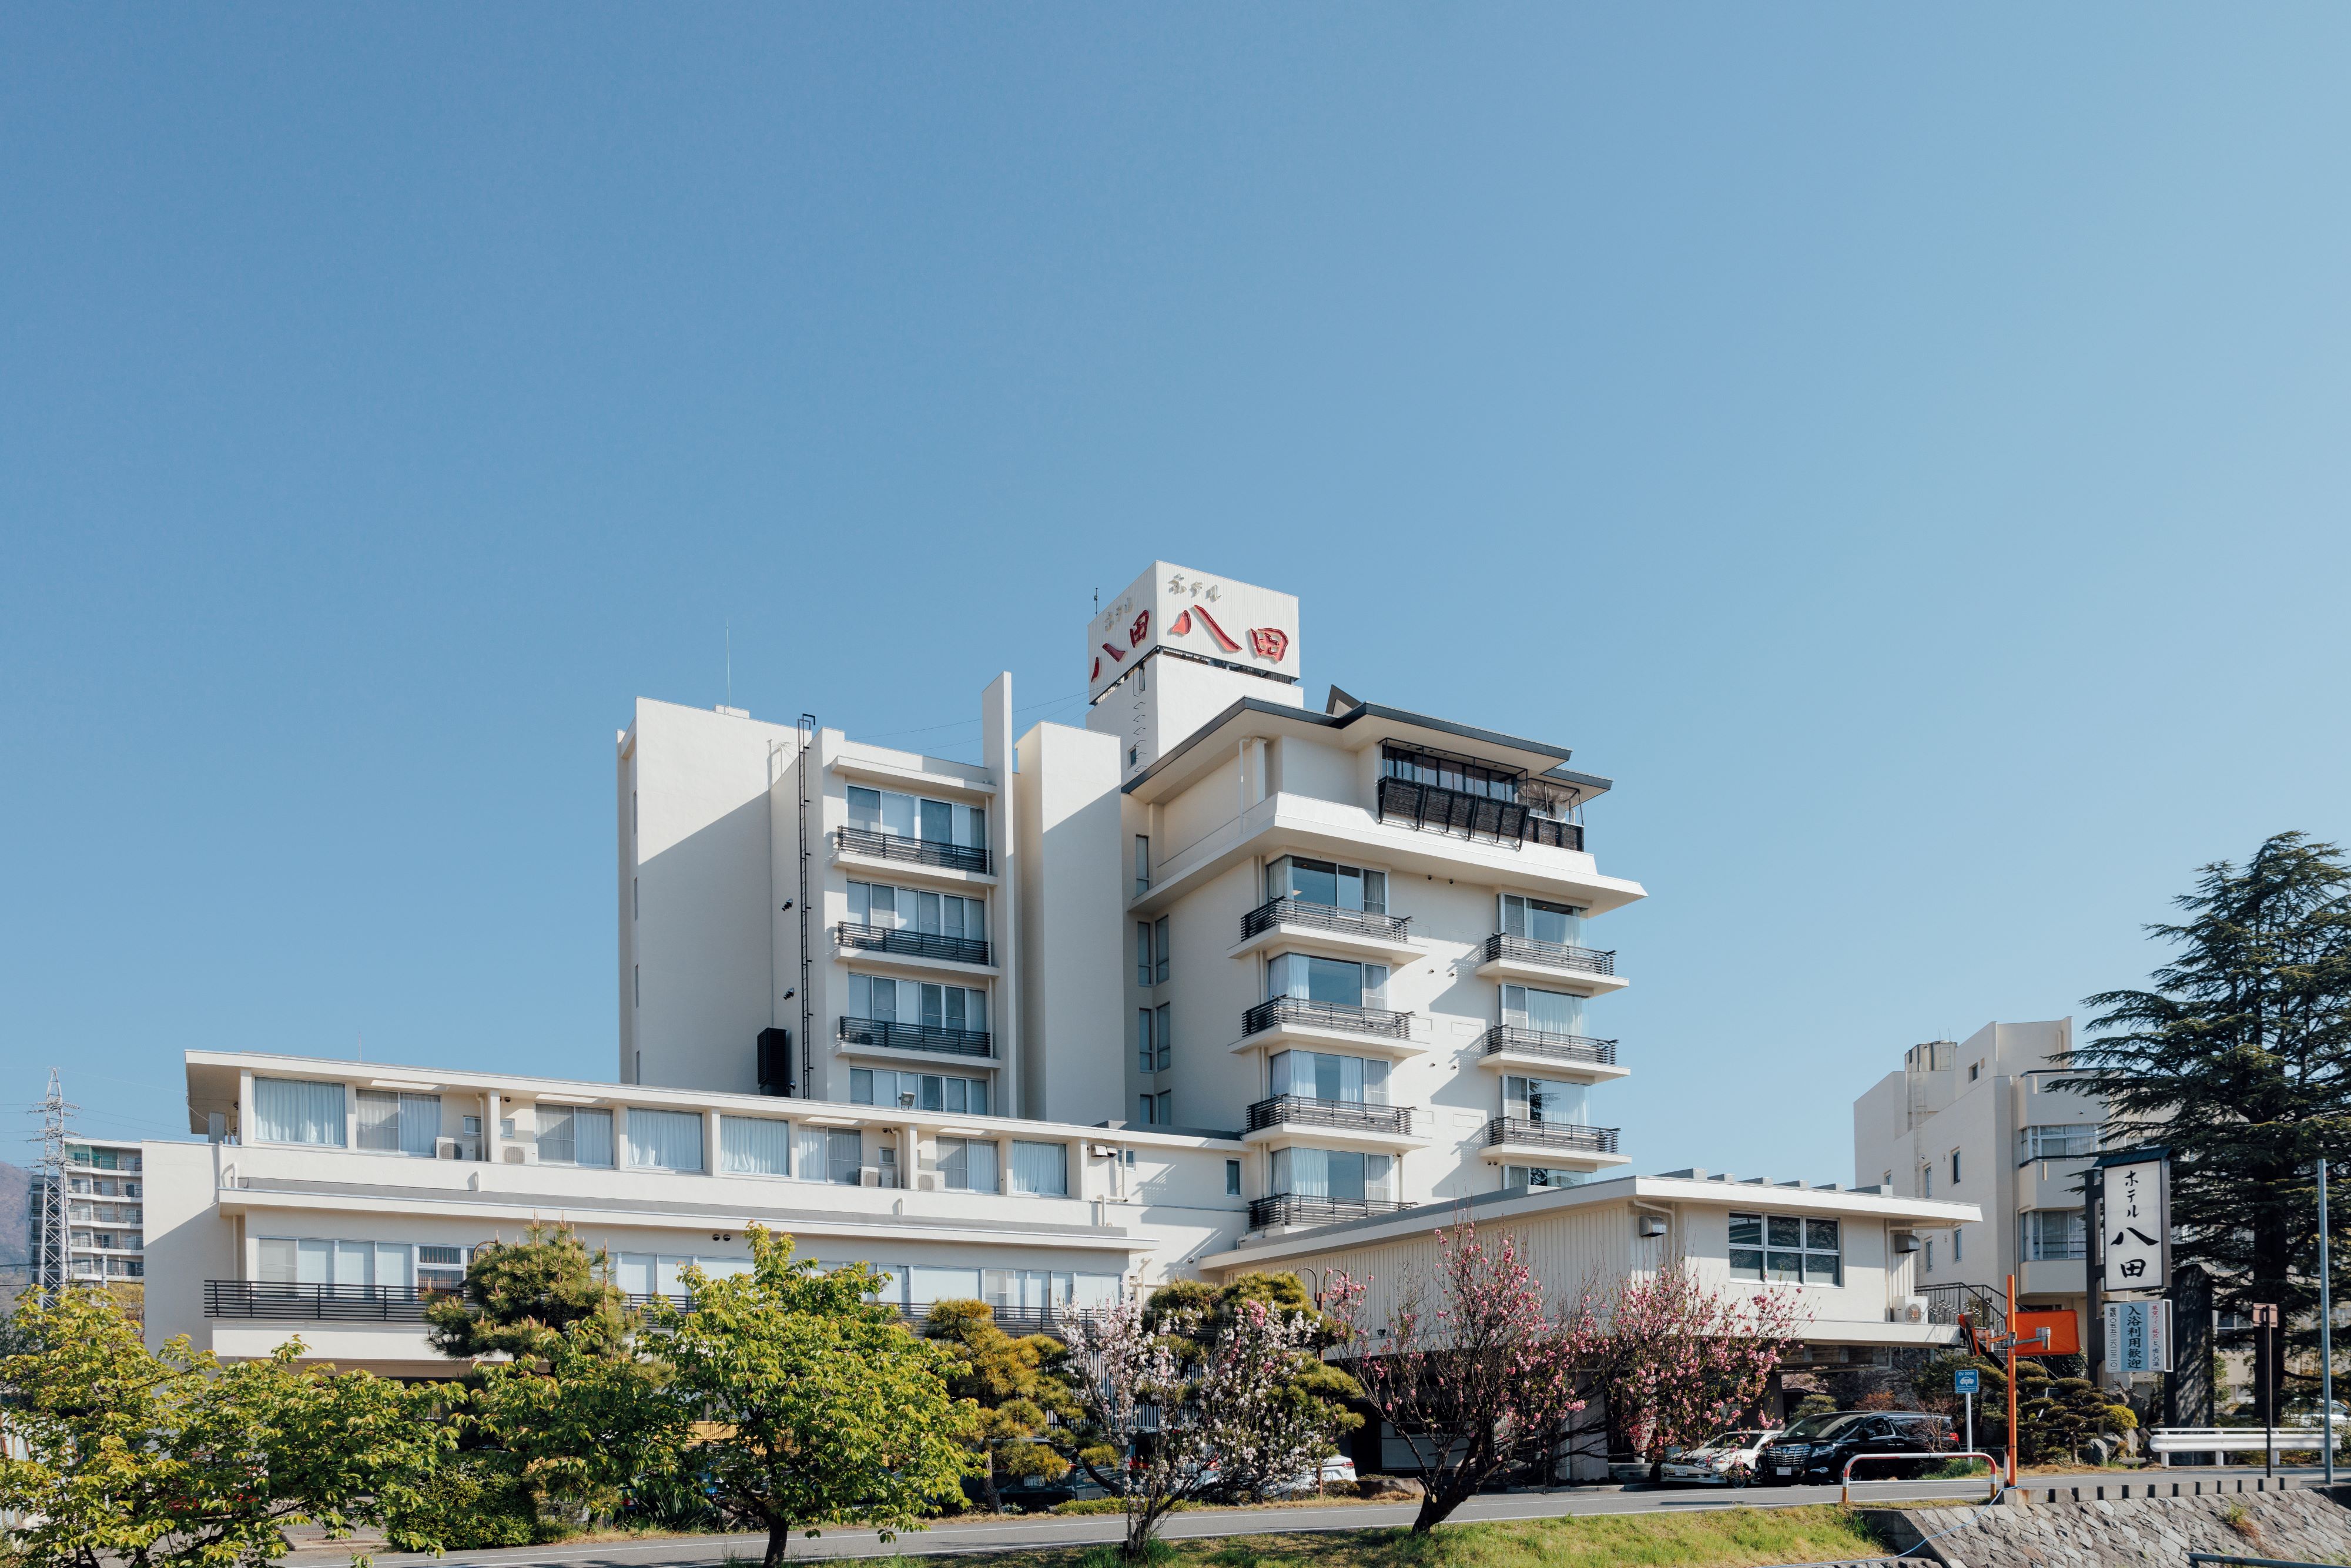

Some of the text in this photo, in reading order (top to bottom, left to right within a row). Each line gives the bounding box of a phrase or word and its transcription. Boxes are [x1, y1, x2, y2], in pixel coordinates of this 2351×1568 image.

[1167, 573, 1222, 603] ホテル
[1091, 609, 1150, 683] 八田
[1171, 604, 1289, 662] 八田
